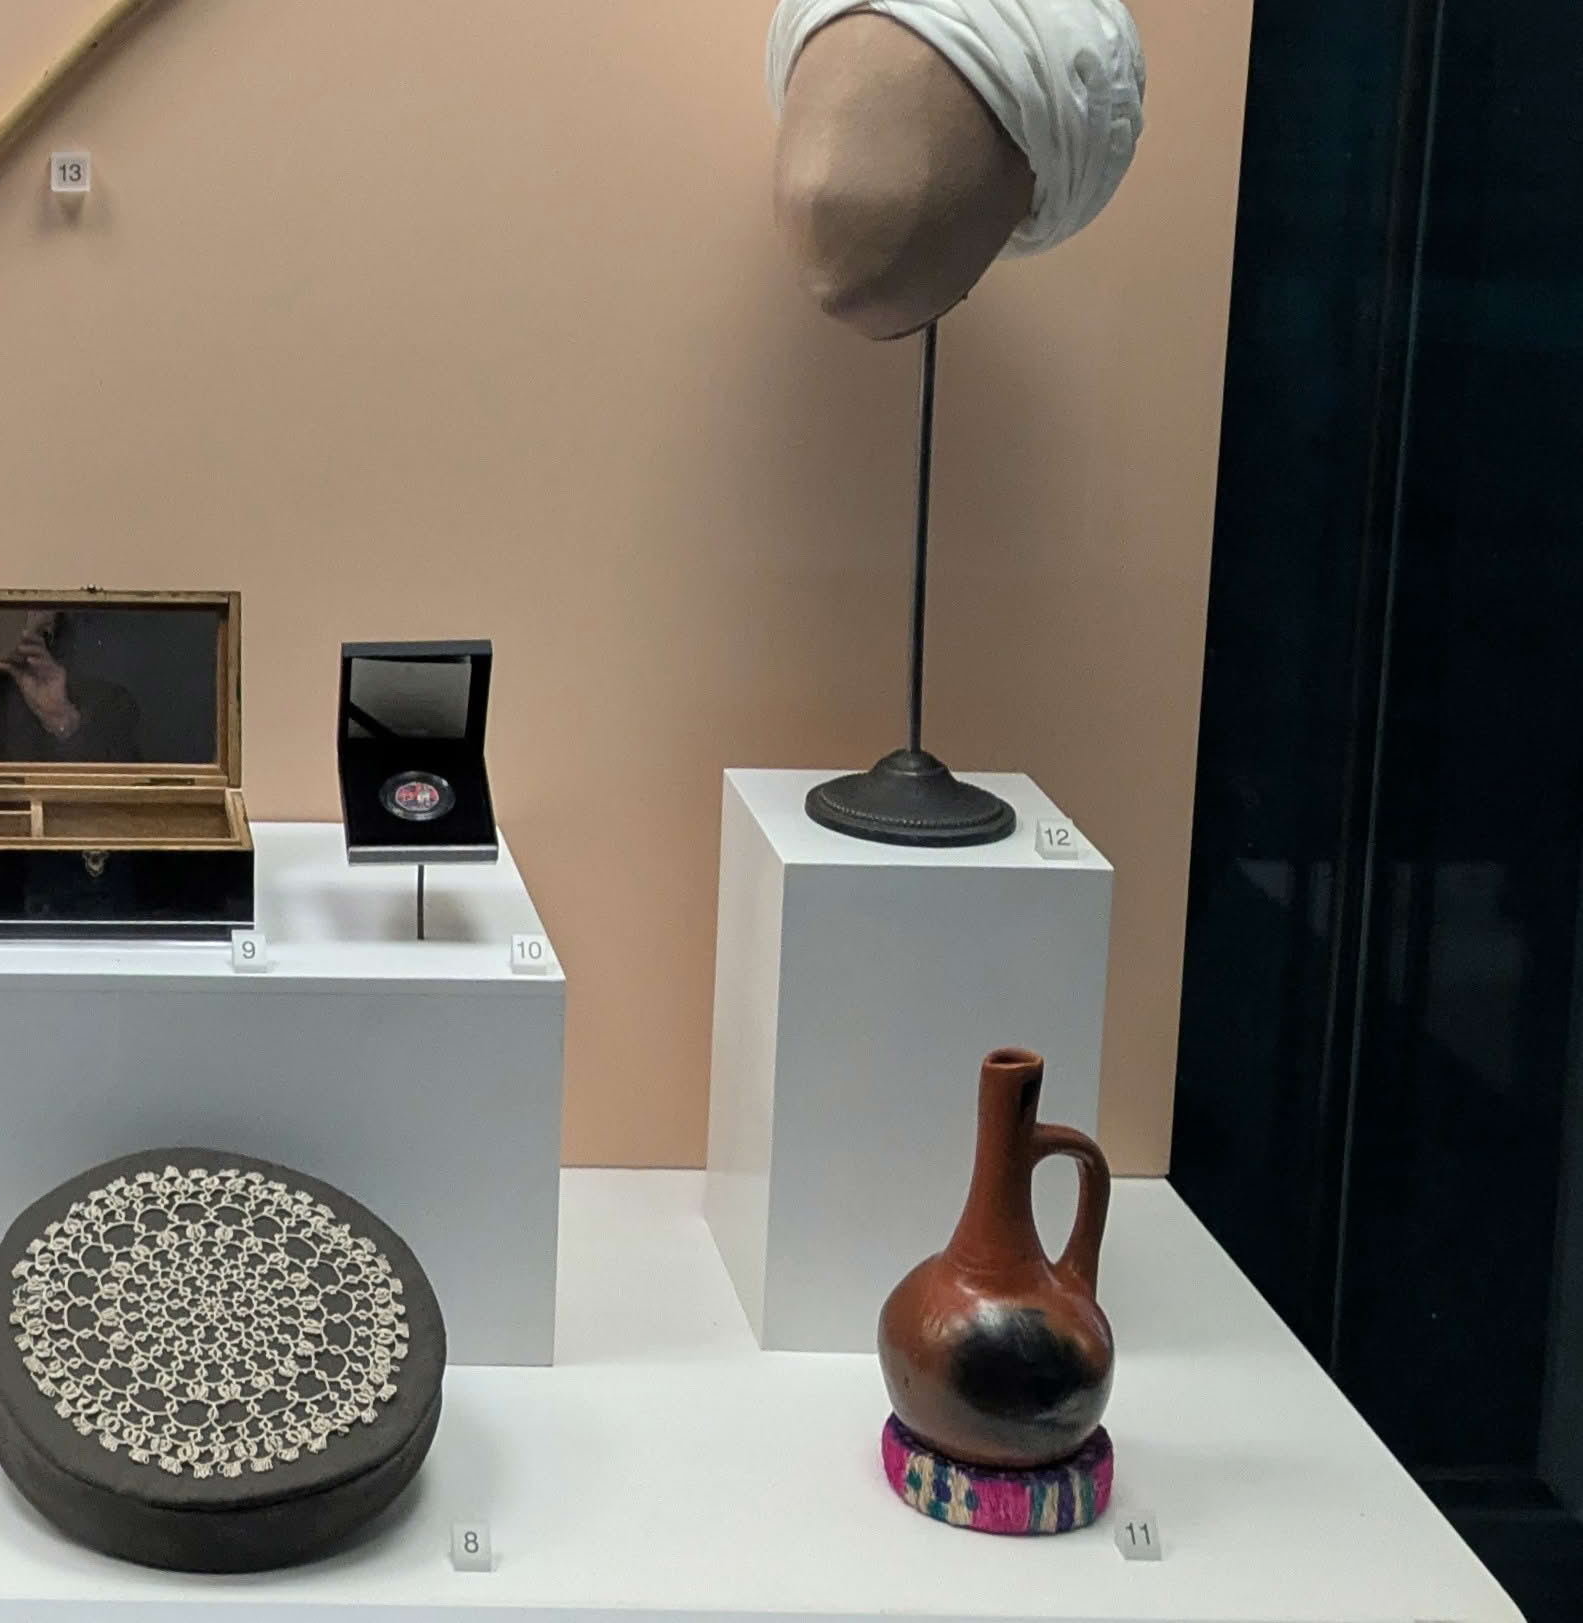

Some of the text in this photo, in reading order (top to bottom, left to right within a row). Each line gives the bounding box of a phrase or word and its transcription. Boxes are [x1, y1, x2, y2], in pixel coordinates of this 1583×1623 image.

[59, 164, 82, 182] 13
[1044, 828, 1071, 846] 12
[241, 941, 256, 959] 9
[518, 941, 542, 959] 10
[463, 1531, 479, 1553] 8
[1125, 1522, 1151, 1545] 11
